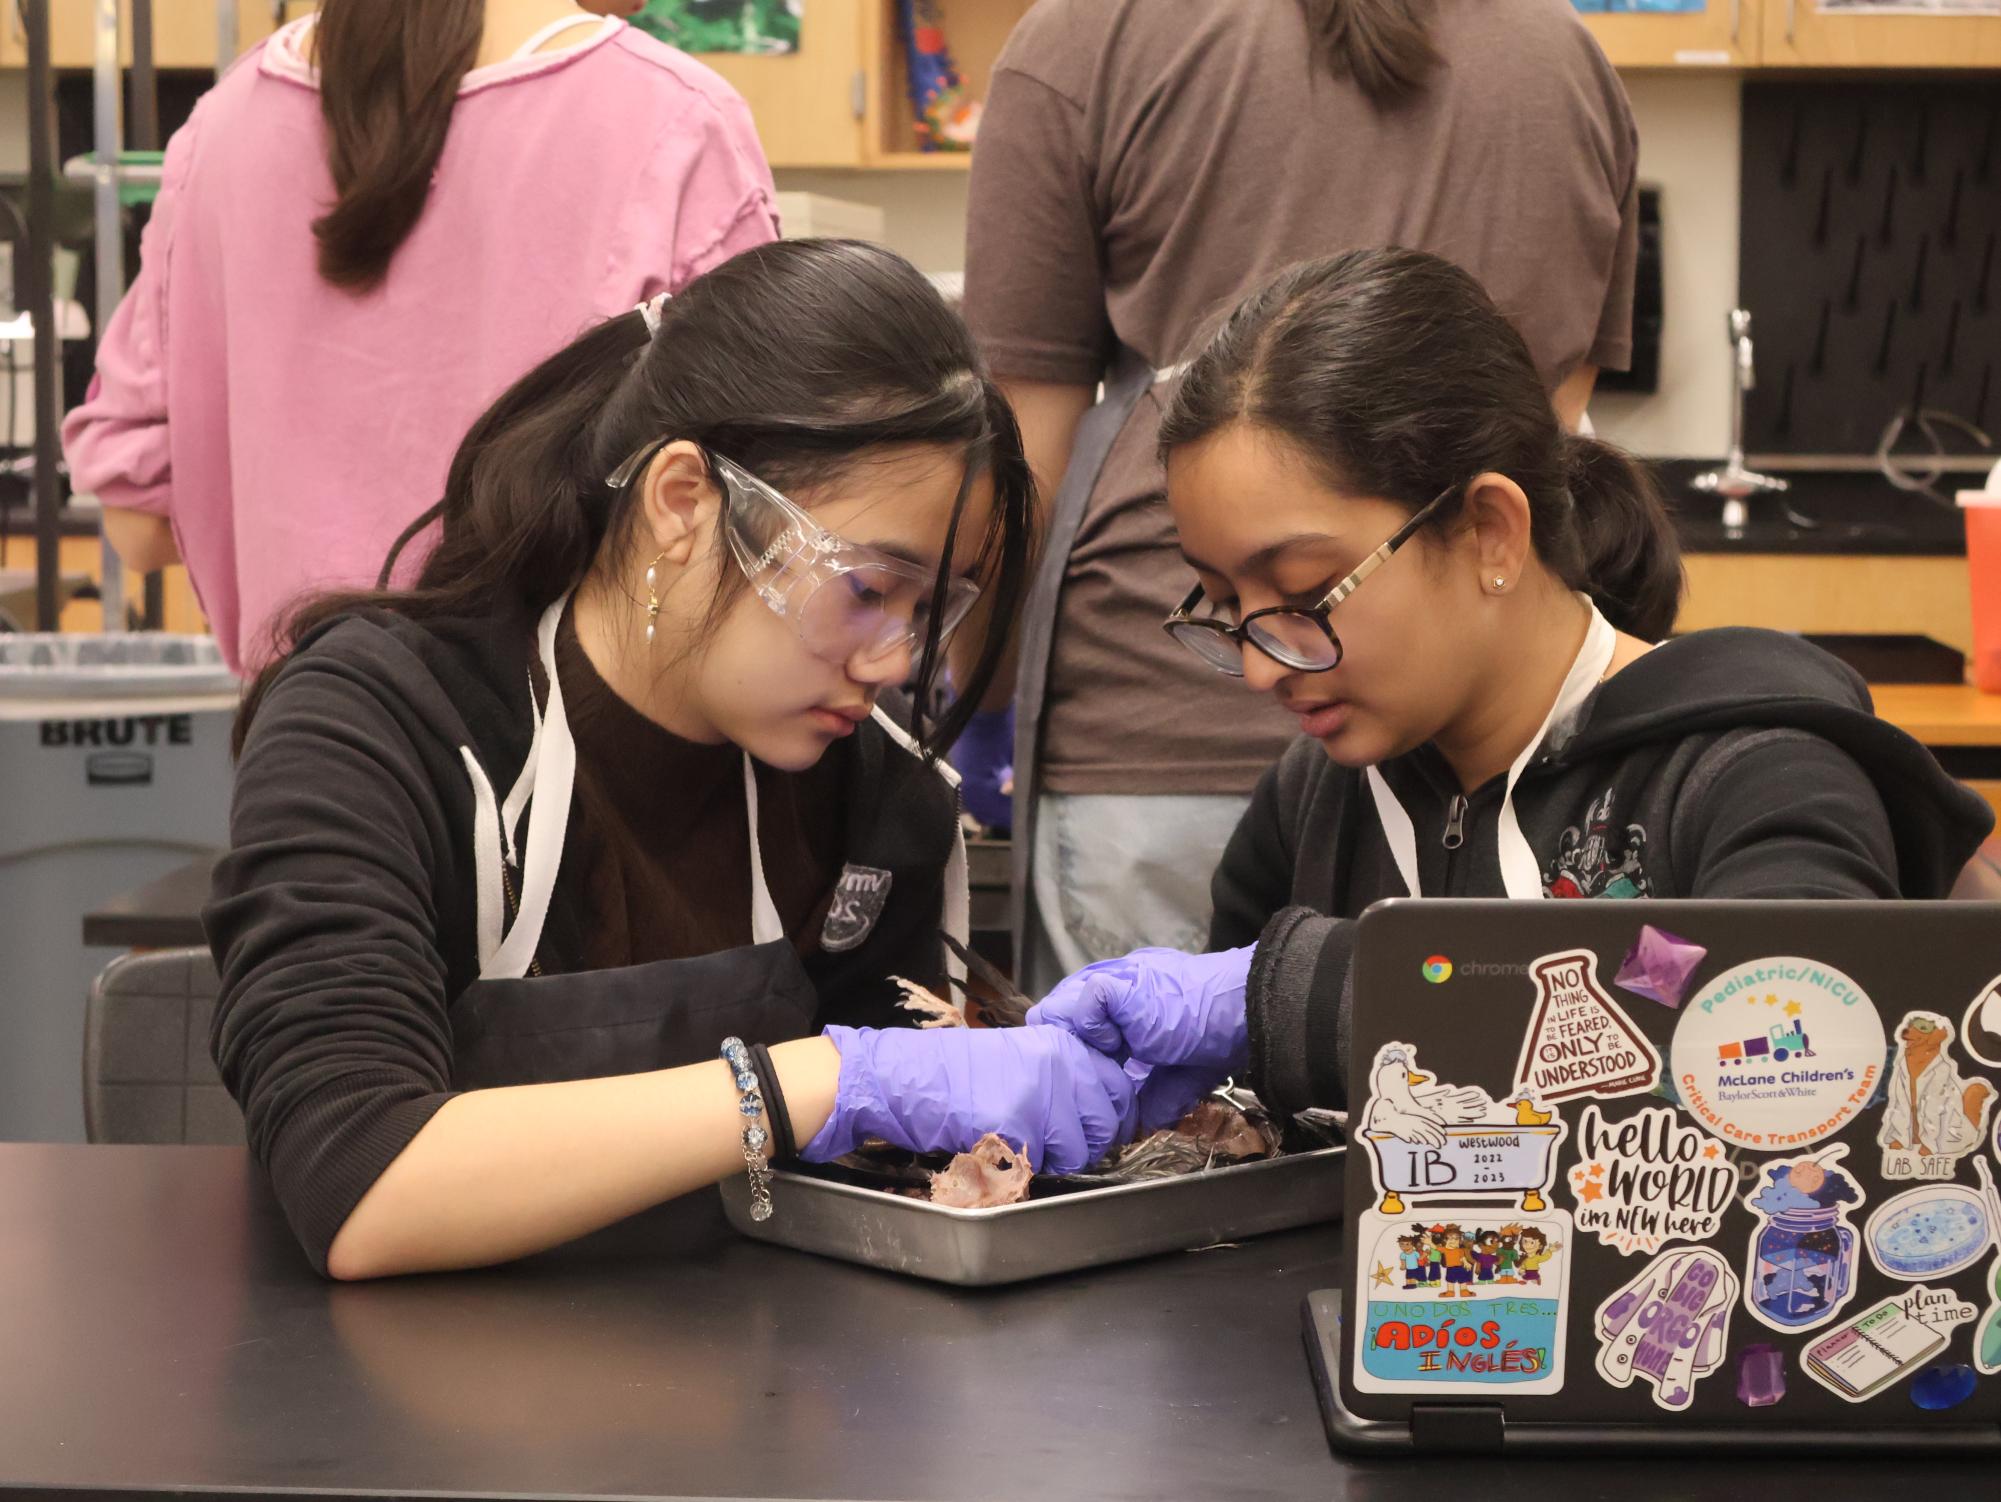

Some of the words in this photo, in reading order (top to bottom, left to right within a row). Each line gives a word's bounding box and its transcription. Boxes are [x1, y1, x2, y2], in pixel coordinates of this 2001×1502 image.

[40, 714, 193, 747] BRUTE
[1460, 959, 1529, 976] chrome
[1551, 969, 1579, 991] NO
[1552, 989, 1589, 1009] THING
[1558, 1006, 1587, 1022] LIFE
[1590, 1005, 1600, 1015] IS
[1539, 1032, 1604, 1063] ONLY
[1606, 1034, 1619, 1042] TO
[1608, 1041, 1622, 1050] BE
[1534, 1051, 1636, 1089] UNDERSTOOD
[1718, 1075, 1776, 1087] McLane
[1682, 1074, 1723, 1126] Critical
[1723, 1123, 1762, 1144] Care
[1767, 1106, 1852, 1145] Transport
[1848, 1064, 1878, 1106] Team
[1585, 1111, 1699, 1164] hello
[1407, 1149, 1457, 1187] IB
[1473, 1153, 1504, 1164] 2022
[1886, 1157, 1912, 1176] LAB
[1920, 1157, 1952, 1176] SAFE
[1473, 1173, 1505, 1184] 2023
[1608, 1159, 1735, 1214] WORLD
[1616, 1205, 1661, 1236] NEW
[1664, 1212, 1717, 1235] here
[1687, 1263, 1714, 1287] GO
[1671, 1282, 1706, 1312] BIG
[1903, 1290, 1950, 1320] plan
[1373, 1304, 1425, 1318] UNO
[1433, 1301, 1472, 1318] DOS
[1917, 1306, 1973, 1325] time
[1638, 1300, 1701, 1349] ORGO
